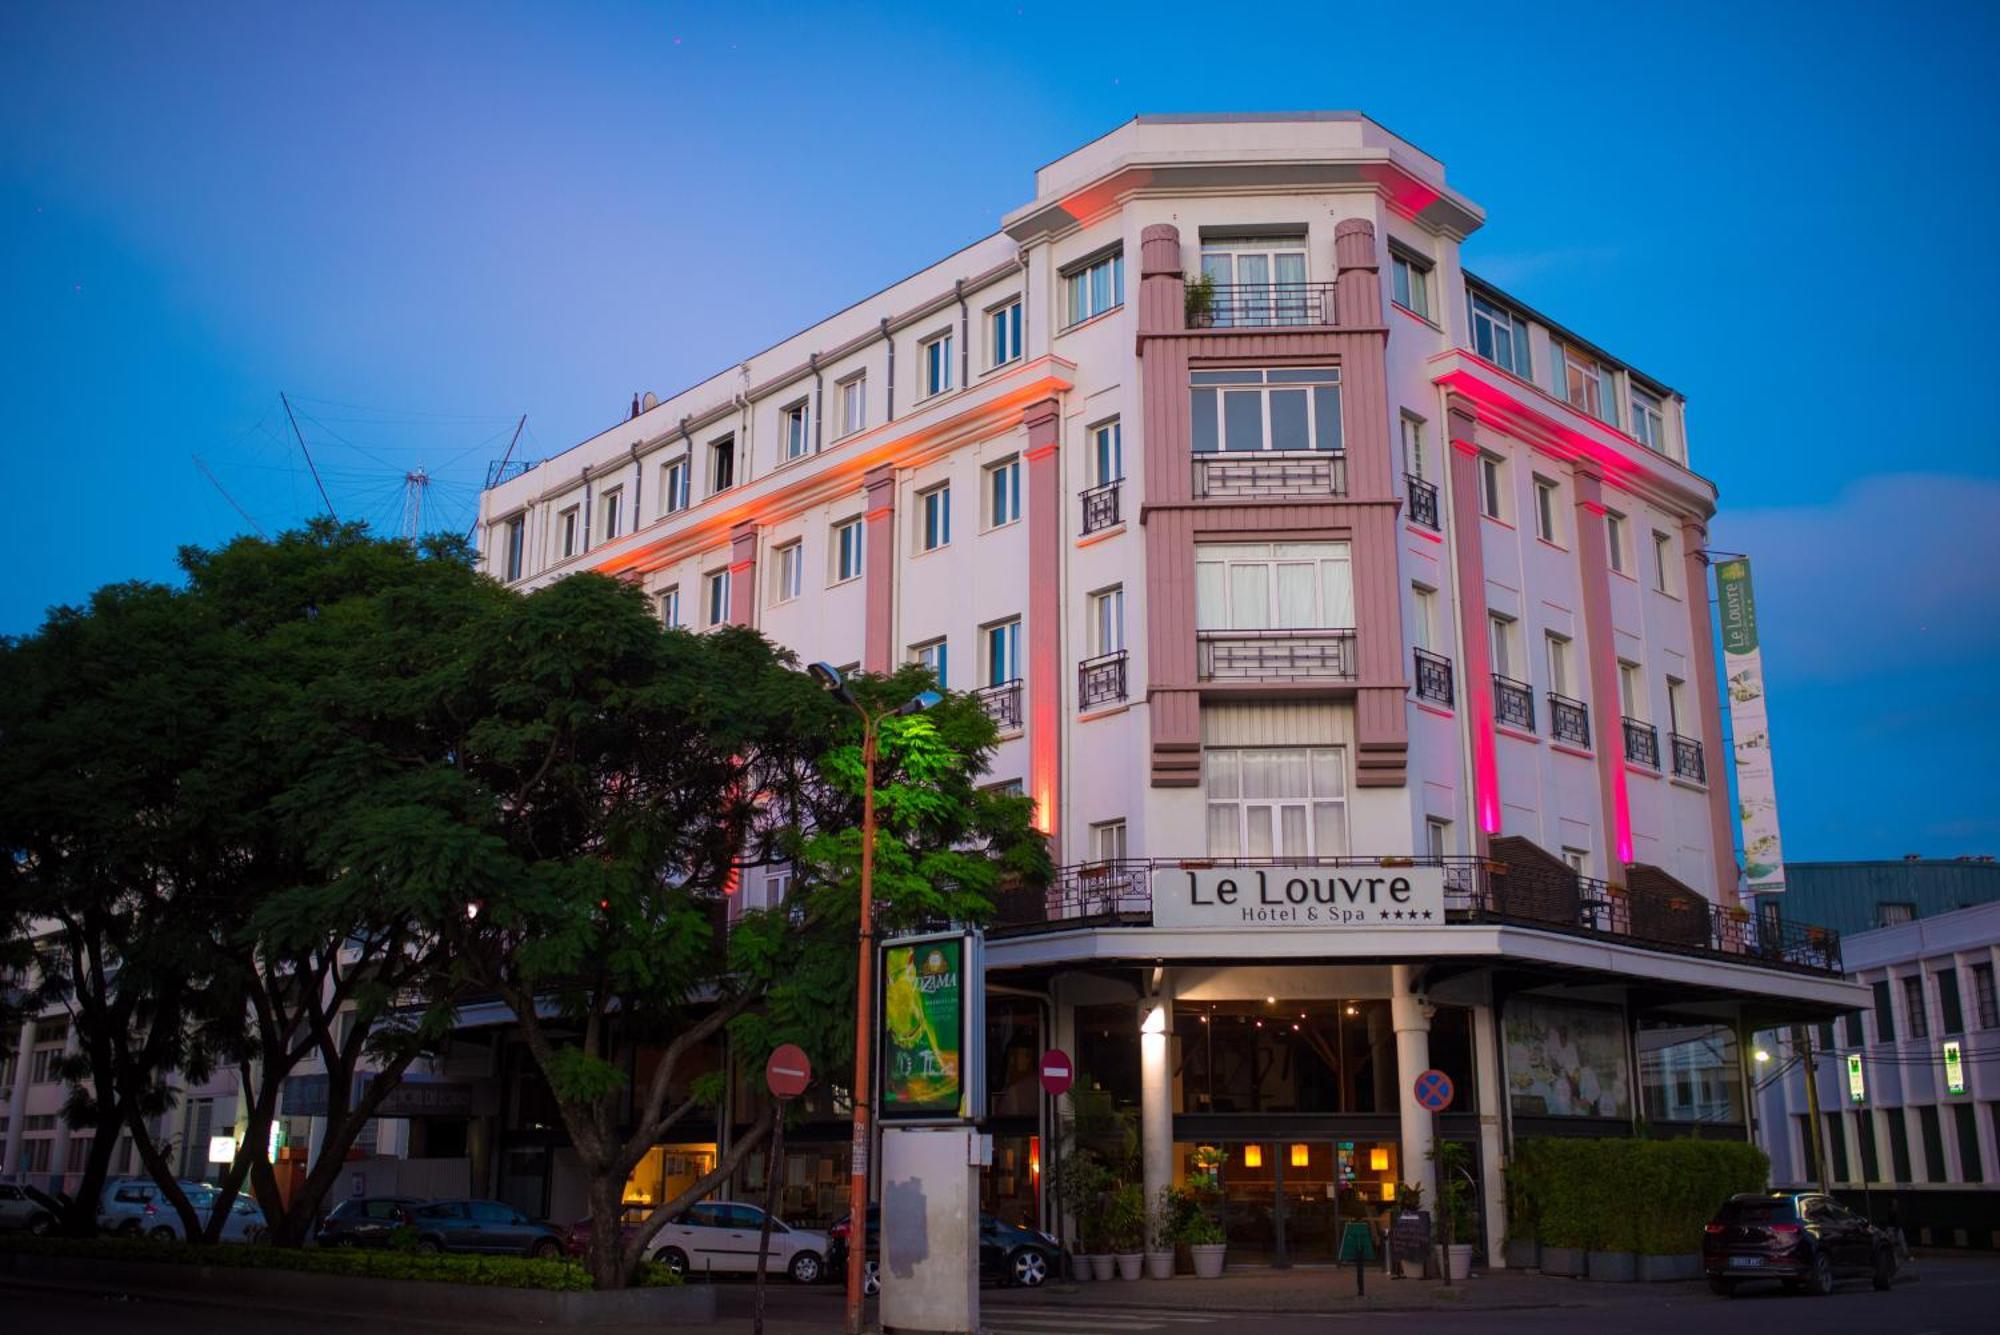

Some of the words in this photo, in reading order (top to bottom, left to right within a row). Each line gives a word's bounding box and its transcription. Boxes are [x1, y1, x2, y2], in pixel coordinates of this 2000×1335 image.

[1726, 583, 1744, 628] Louvre
[1727, 631, 1745, 648] Le
[1186, 871, 1238, 905] Le
[1255, 870, 1411, 904] Louvre
[1242, 907, 1296, 921] Hôtel
[1307, 906, 1318, 921] &
[1329, 906, 1365, 923] Spa
